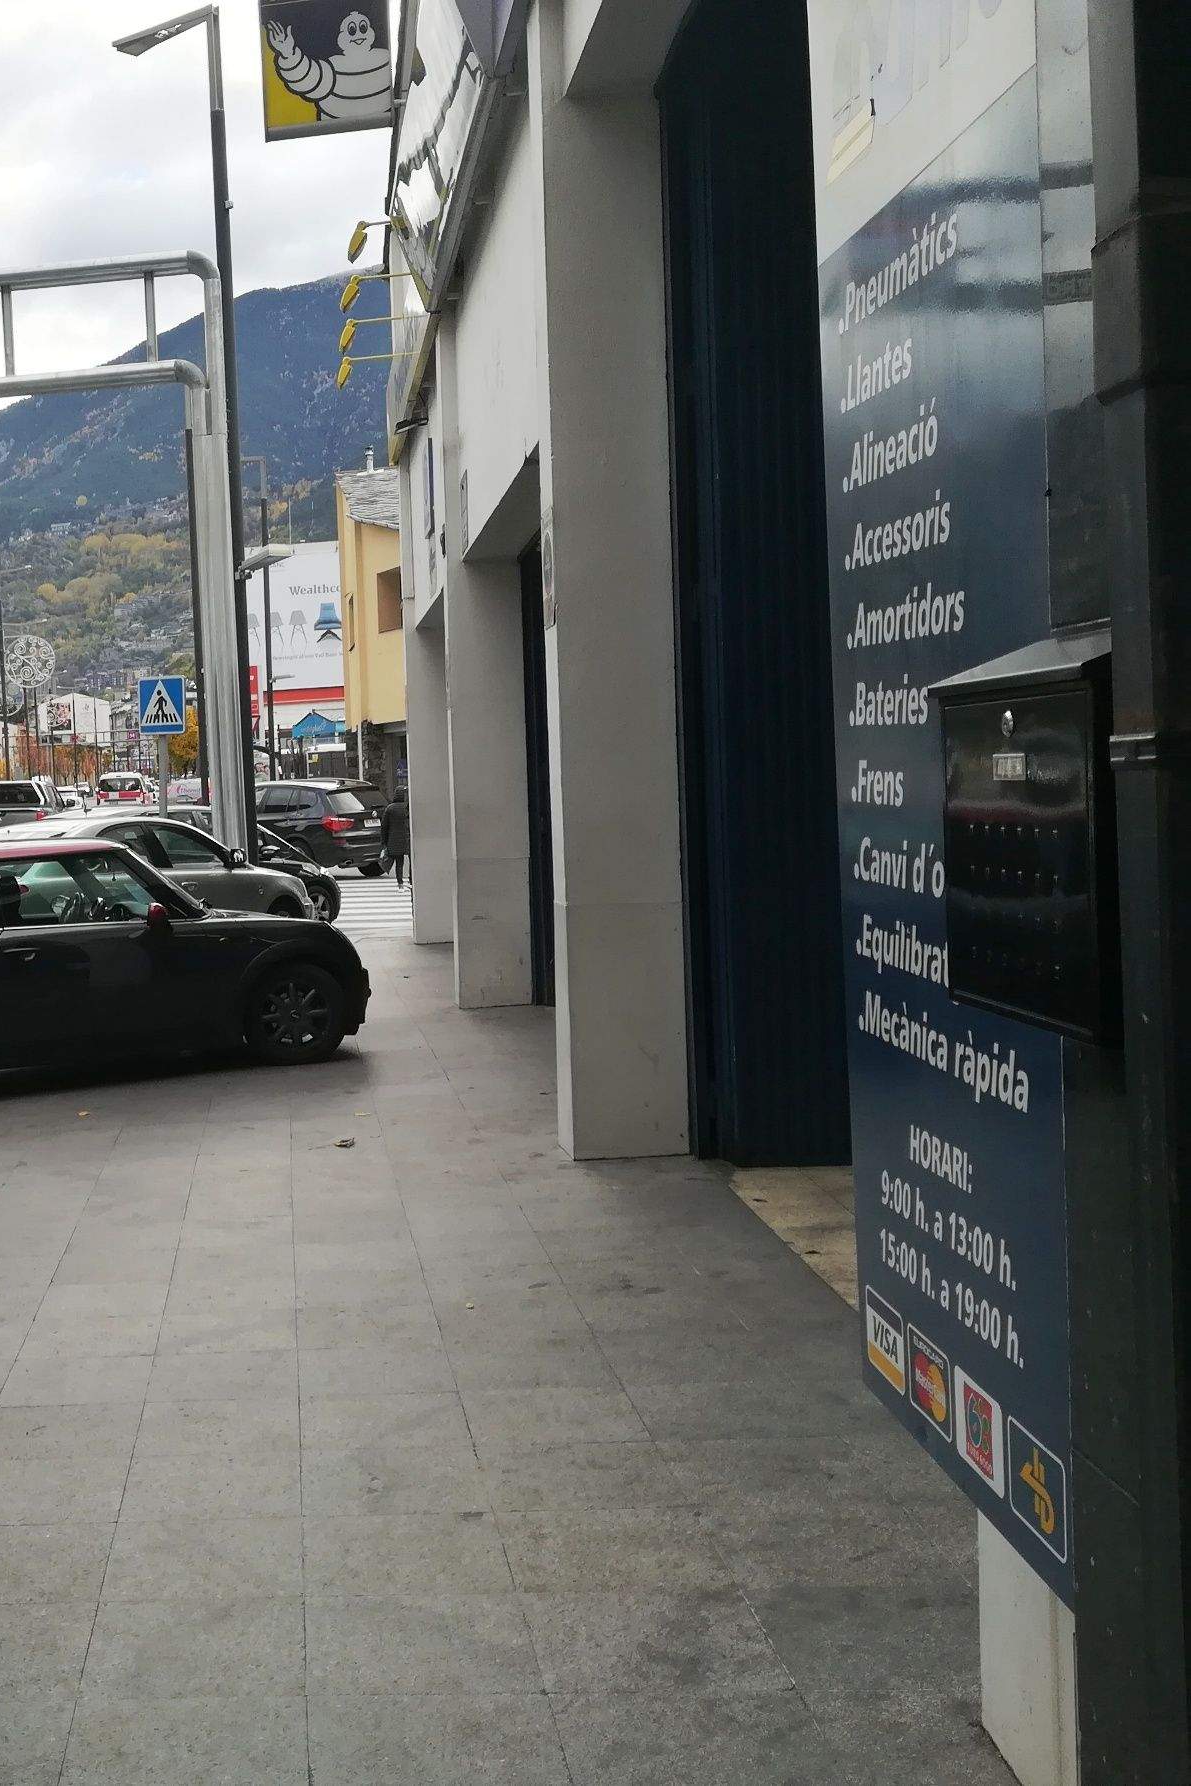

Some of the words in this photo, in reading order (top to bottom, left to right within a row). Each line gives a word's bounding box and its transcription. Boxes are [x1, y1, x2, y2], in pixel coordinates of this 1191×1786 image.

[954, 1030, 1029, 1113] ràpida
[909, 1124, 972, 1194] HORARI:
[881, 1169, 911, 1220] 9:00
[915, 1187, 929, 1233] h.
[933, 1211, 943, 1241] a
[949, 1212, 994, 1275] 13:00
[999, 1238, 1016, 1291] h.
[872, 1316, 898, 1364] VISA
[880, 1228, 917, 1285] 15:00
[922, 1253, 936, 1300] h.
[940, 1279, 949, 1311] a
[955, 1282, 1001, 1349] 19:00
[1006, 1315, 1024, 1369] h.
